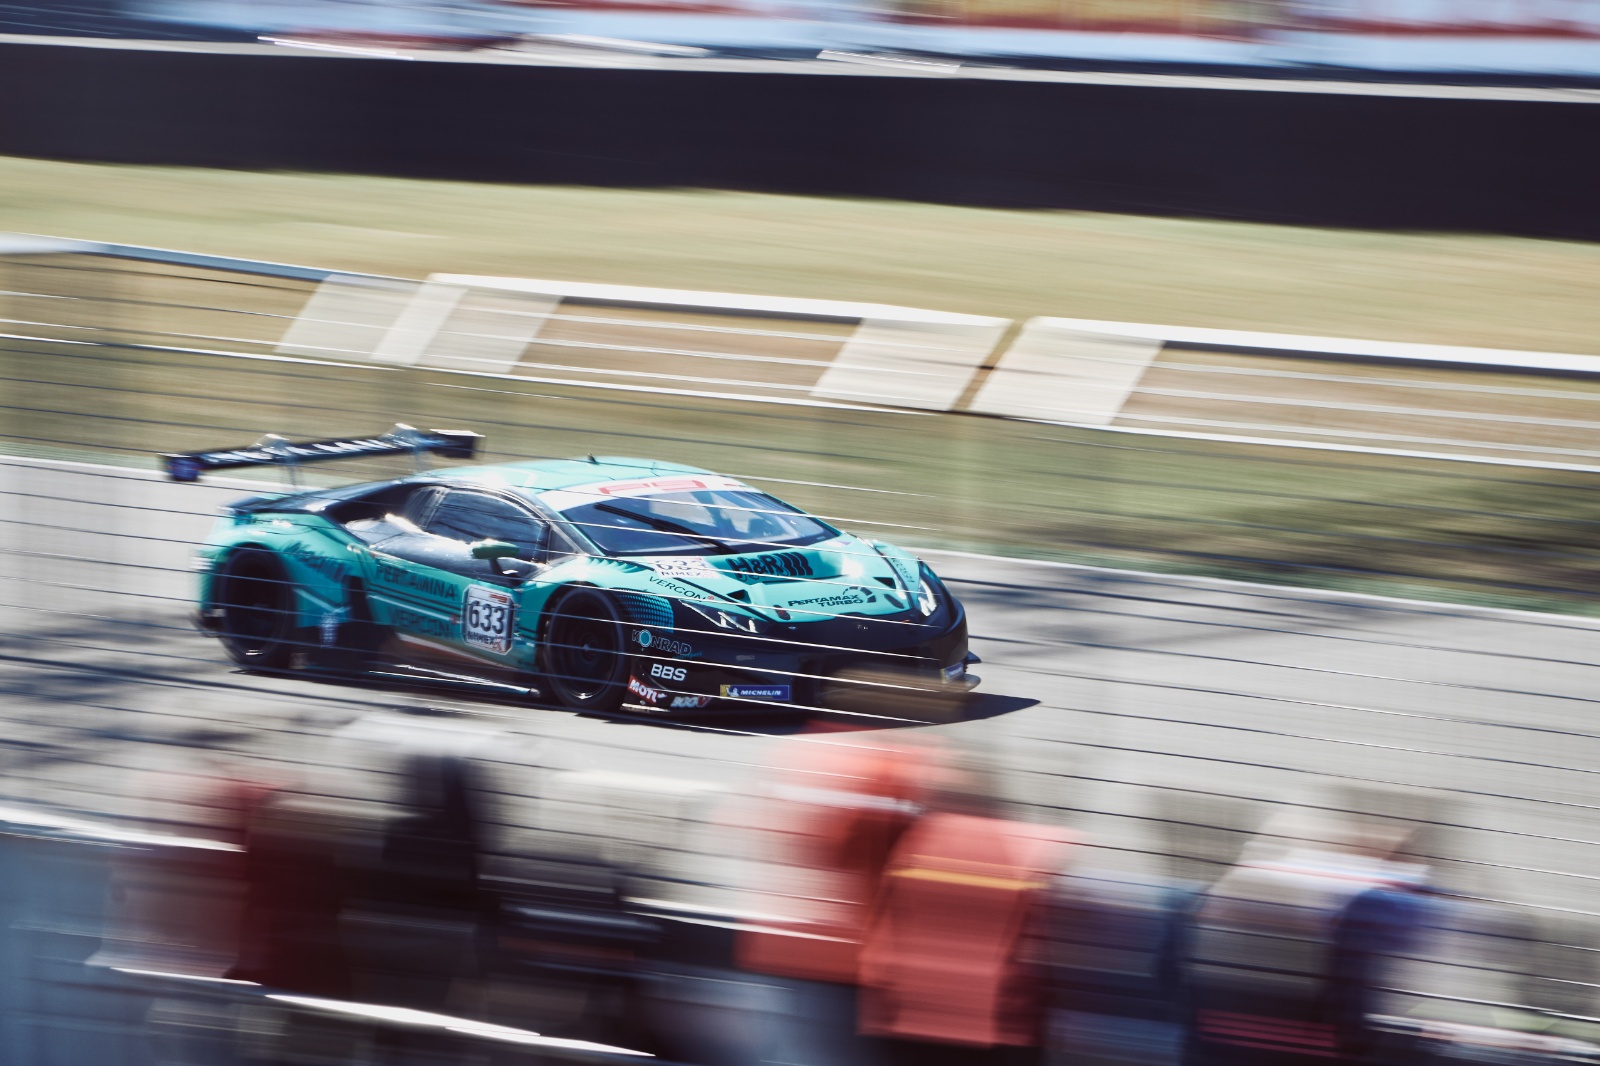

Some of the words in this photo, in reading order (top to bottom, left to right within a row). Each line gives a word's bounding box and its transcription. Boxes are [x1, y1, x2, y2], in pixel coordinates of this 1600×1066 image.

[725, 553, 785, 580] H&R
[376, 562, 457, 599] PERTAMINA
[788, 594, 860, 607] PERTAMAX
[817, 599, 864, 607] TURBO
[468, 600, 505, 634] 633
[631, 629, 692, 655] KONRAD
[650, 663, 687, 681] BBS
